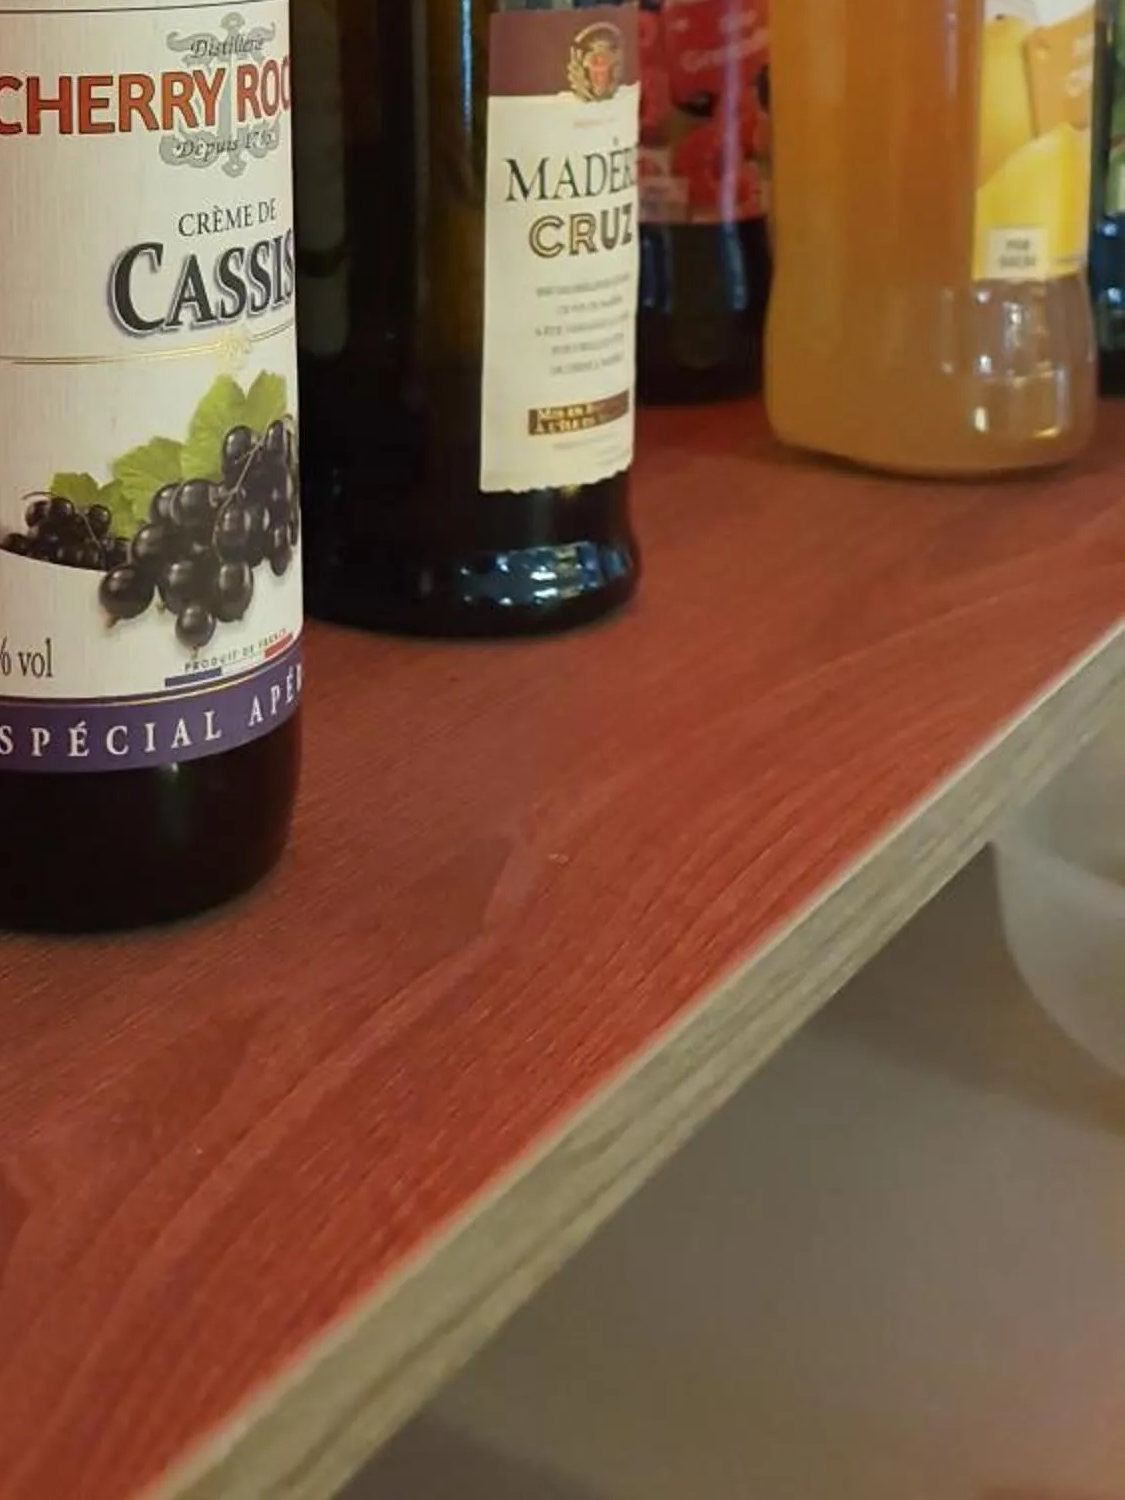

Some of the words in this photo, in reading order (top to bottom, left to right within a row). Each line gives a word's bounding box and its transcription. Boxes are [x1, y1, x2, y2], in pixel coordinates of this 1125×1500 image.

[178, 204, 252, 237] CRÈME
[257, 197, 277, 225] DE
[528, 202, 633, 260] CRUZ
[18, 638, 53, 678] vol
